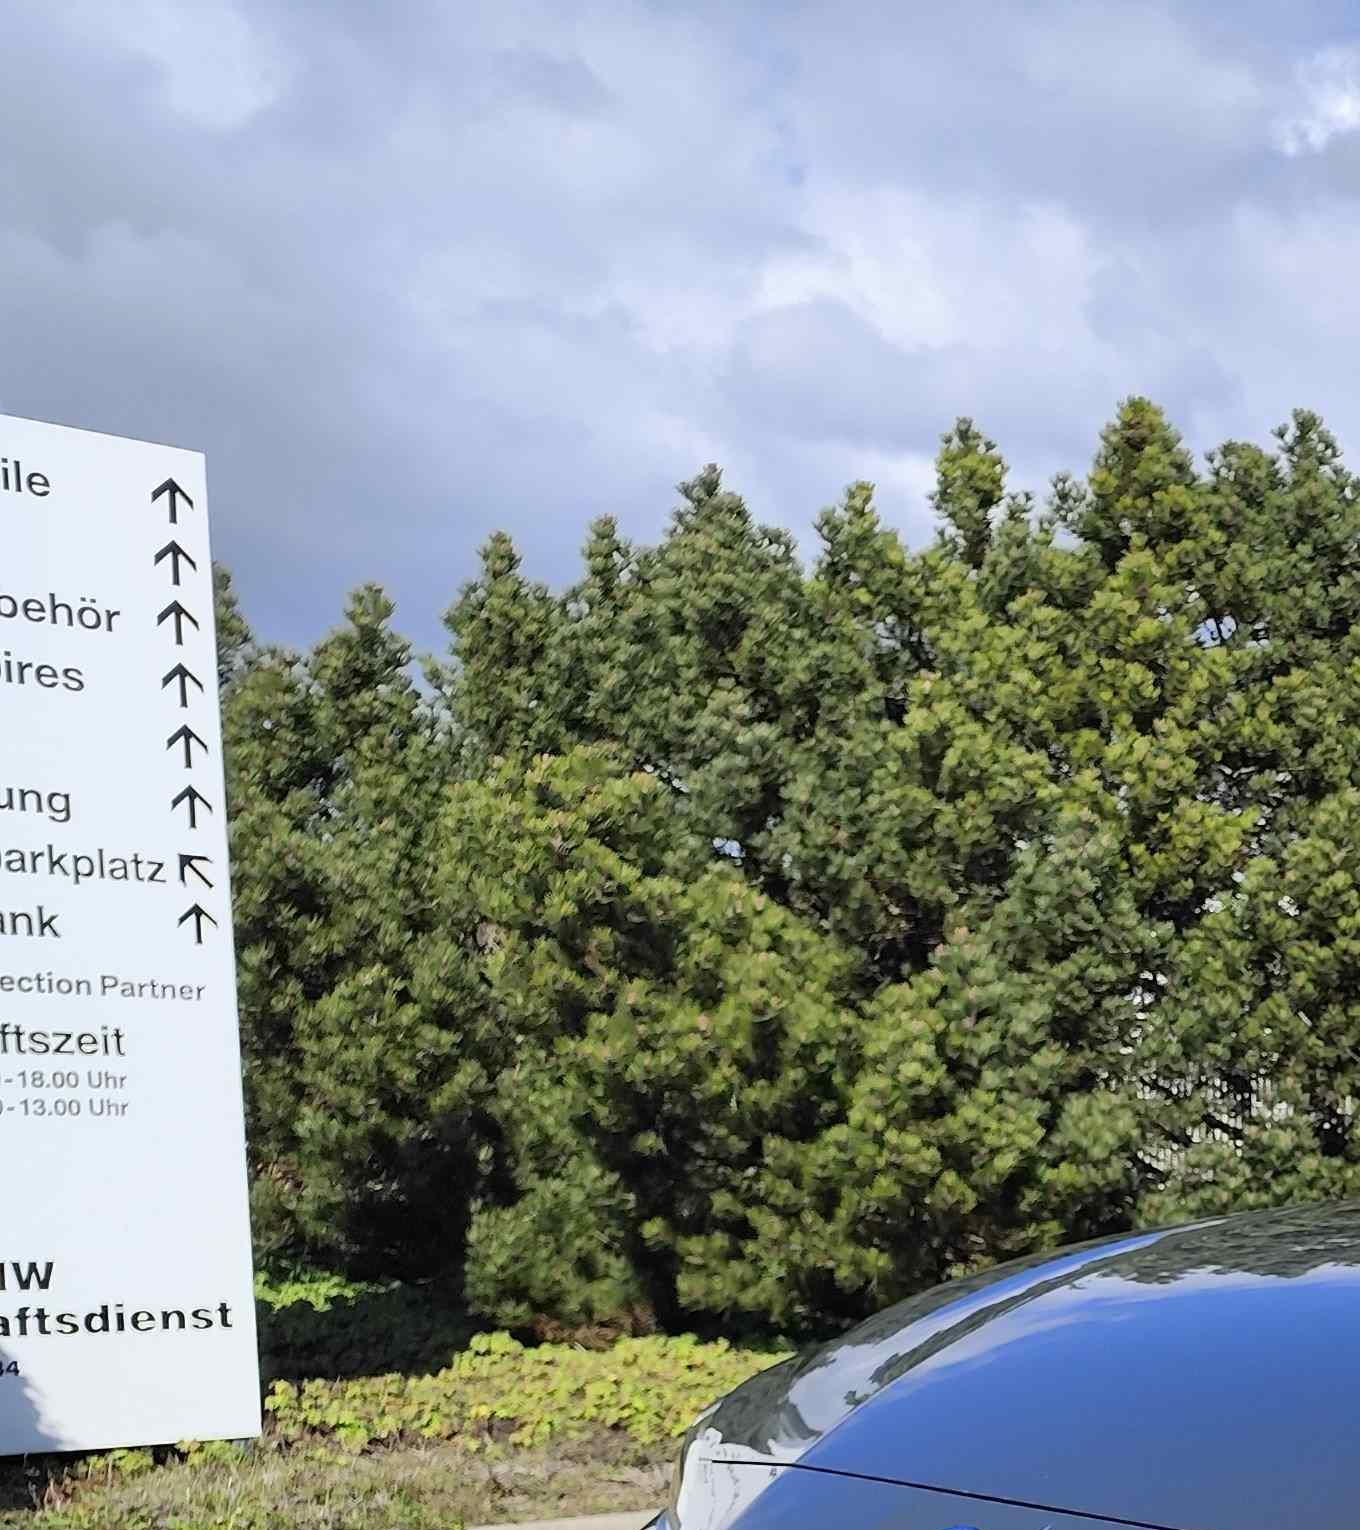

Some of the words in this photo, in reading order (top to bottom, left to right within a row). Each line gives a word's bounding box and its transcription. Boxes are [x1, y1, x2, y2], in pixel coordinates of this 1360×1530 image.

[1, 457, 51, 497] ile
[0, 651, 85, 692] ires
[0, 844, 168, 885] arkplatz
[101, 974, 207, 1001] Partner
[87, 1069, 128, 1090] Uhr
[89, 1097, 129, 1118] Uhr
